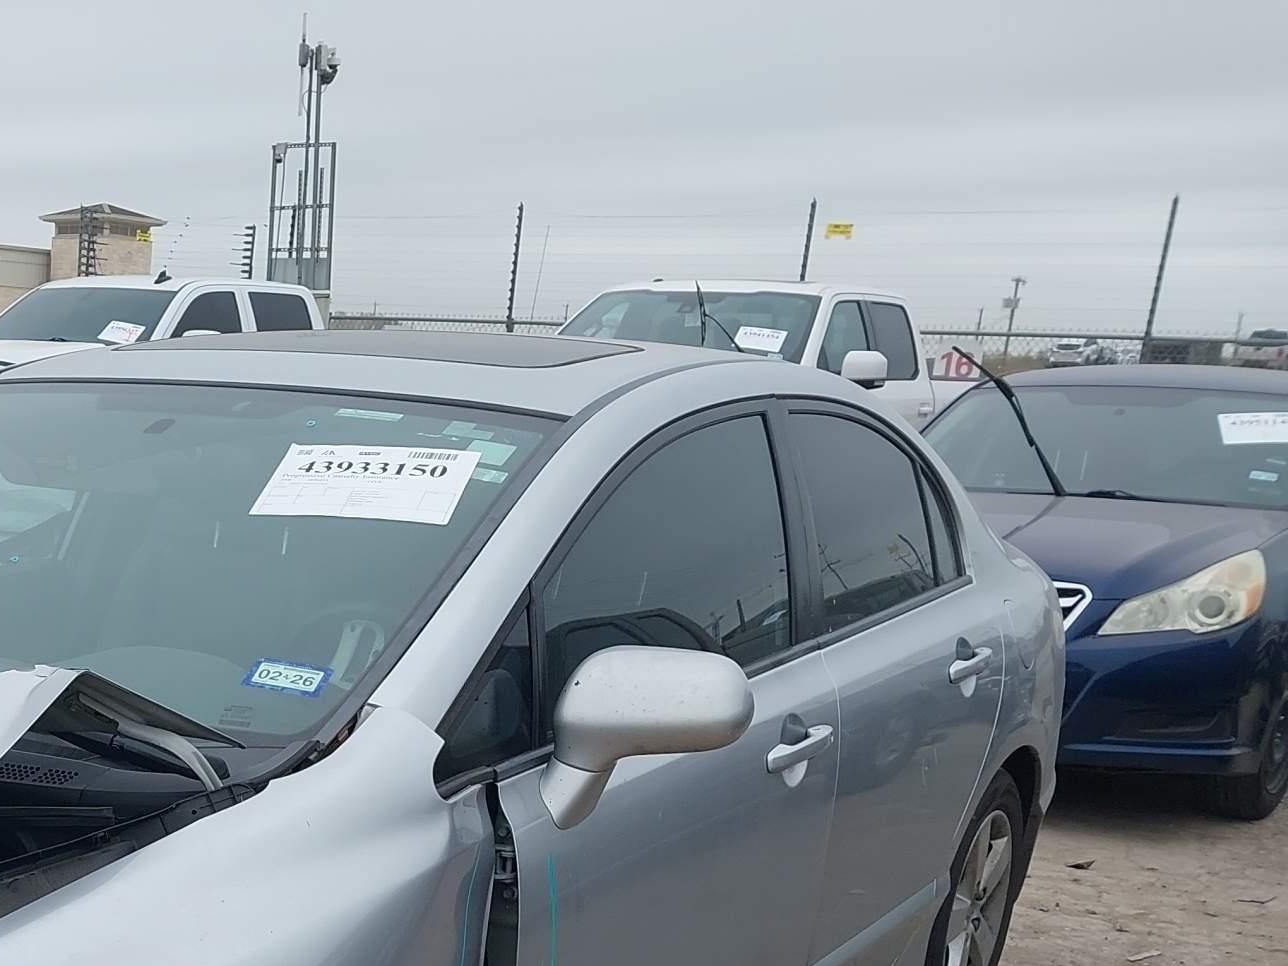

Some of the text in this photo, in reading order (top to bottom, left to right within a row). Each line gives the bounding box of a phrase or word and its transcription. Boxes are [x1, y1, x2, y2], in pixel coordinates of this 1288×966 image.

[941, 351, 974, 377] 16
[298, 460, 448, 478] 43933150
[258, 669, 315, 687] 02 26
